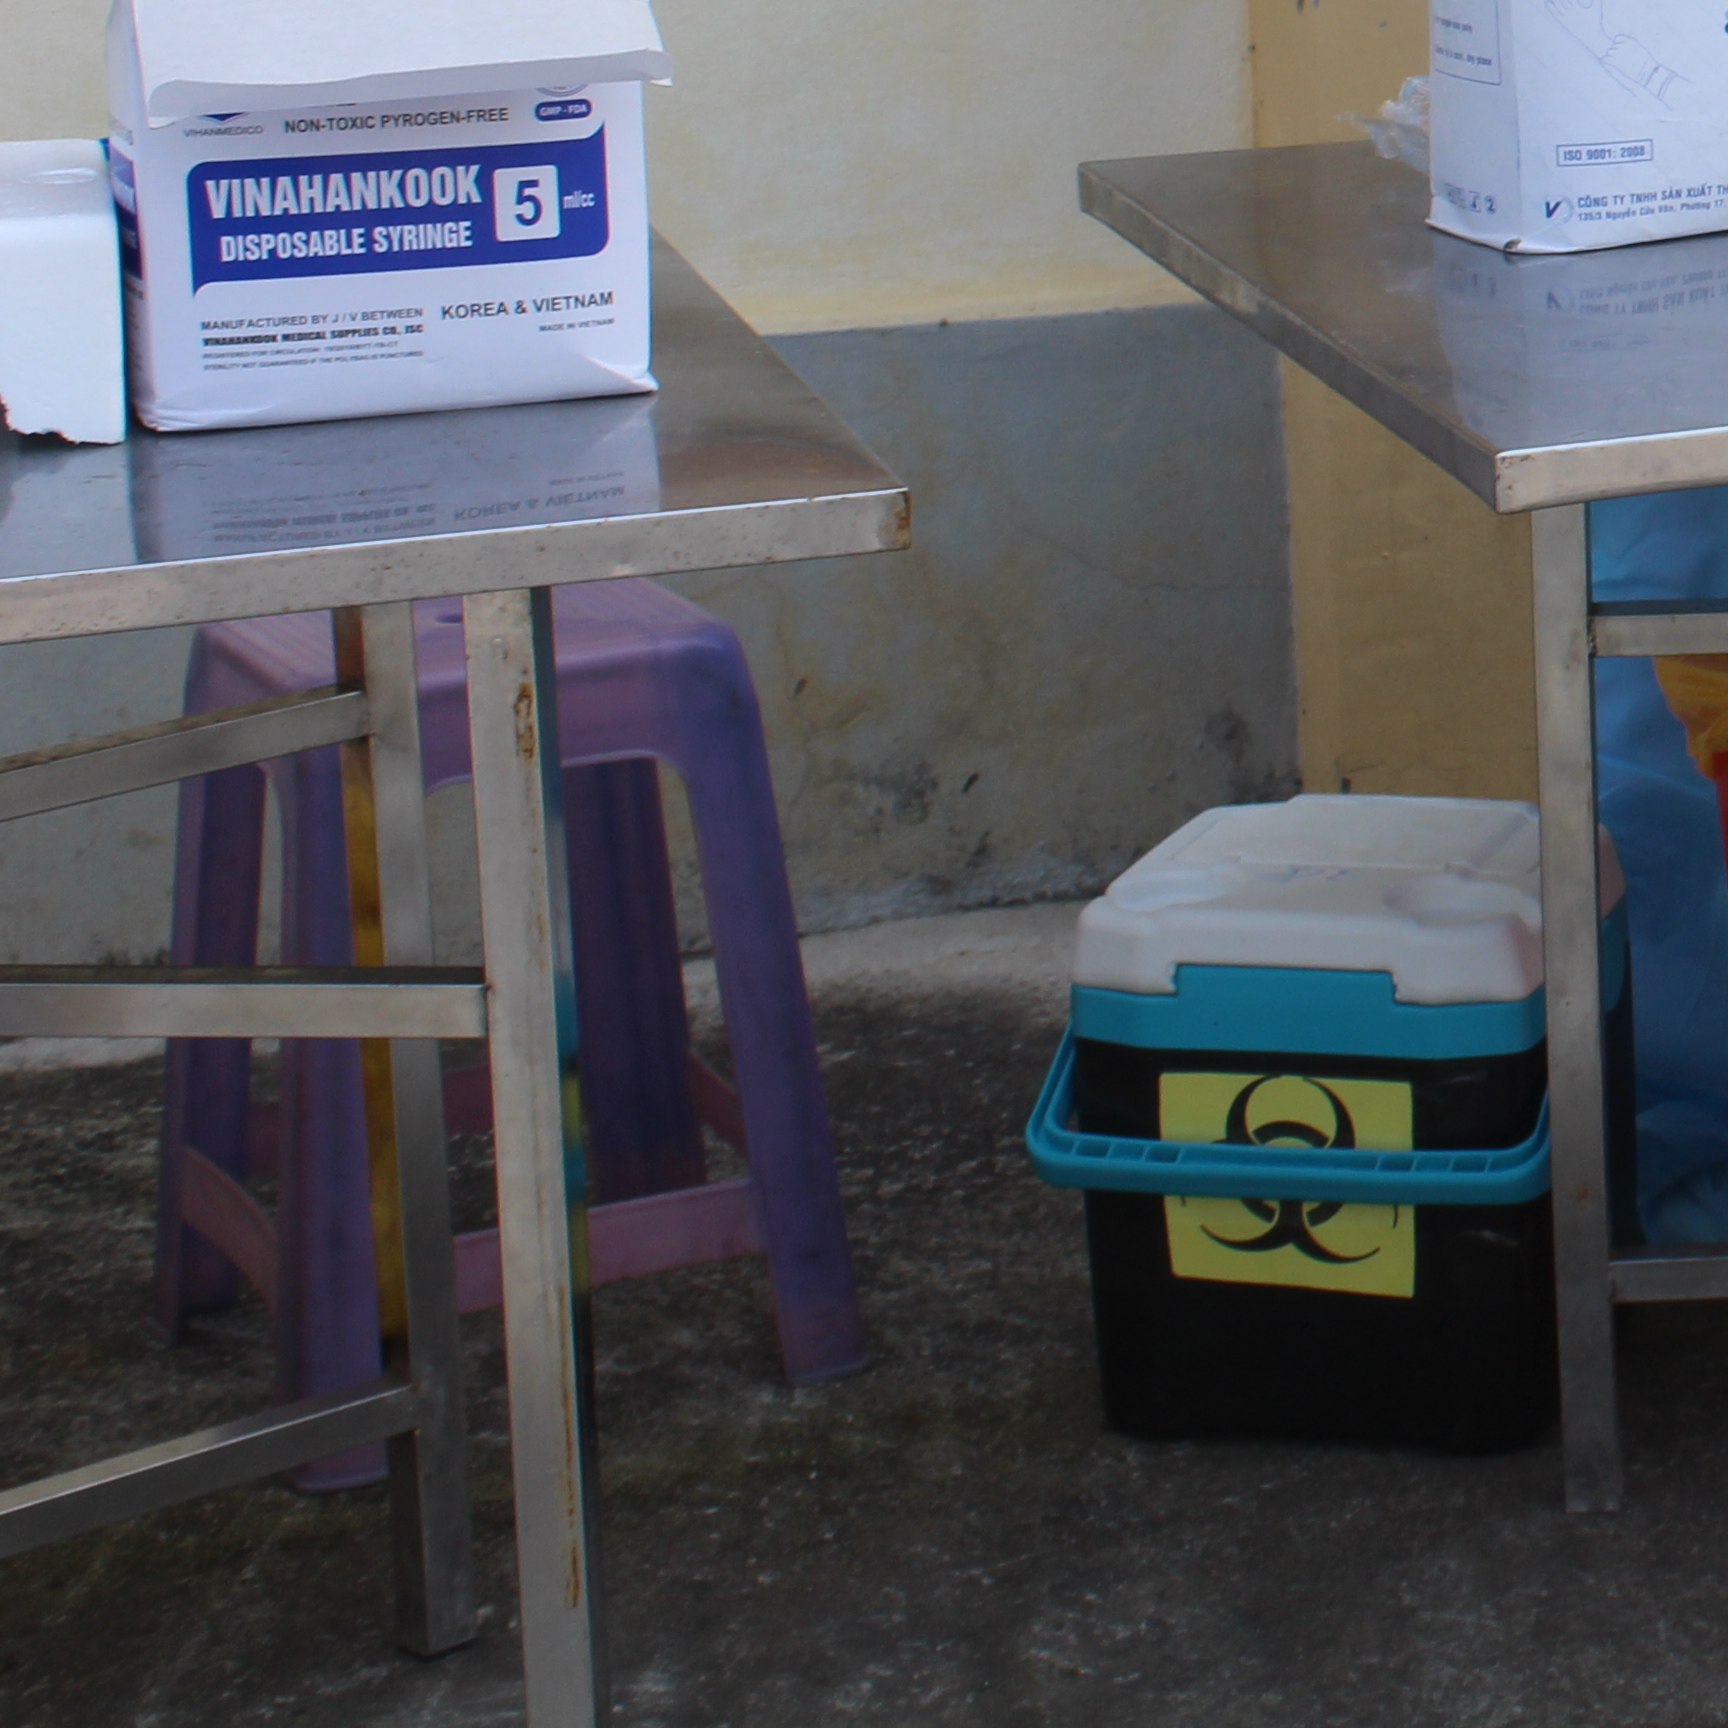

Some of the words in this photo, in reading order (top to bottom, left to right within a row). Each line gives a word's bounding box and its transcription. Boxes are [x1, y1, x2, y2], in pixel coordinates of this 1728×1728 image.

[285, 115, 376, 134] NON-TOXIC
[380, 107, 509, 128] PYROGEN-FREE
[1563, 150, 1582, 161] ISO
[205, 165, 482, 219] VINAHANKOOK
[514, 178, 544, 227] 5
[1612, 194, 1625, 206] TY
[1630, 191, 1657, 204] TNHH
[220, 227, 366, 262] DISPOSABLE
[373, 220, 473, 254] SYRINGE
[441, 302, 509, 320] KOREA
[514, 300, 527, 314] &
[532, 291, 614, 312] VIETNAM
[201, 314, 309, 331] MANUFACTURED
[311, 313, 329, 325] BY
[361, 308, 423, 321] BETWEEN
[539, 324, 565, 332] MADE
[281, 330, 327, 342] MEDICAL
[330, 326, 379, 339] SUPPLIES
